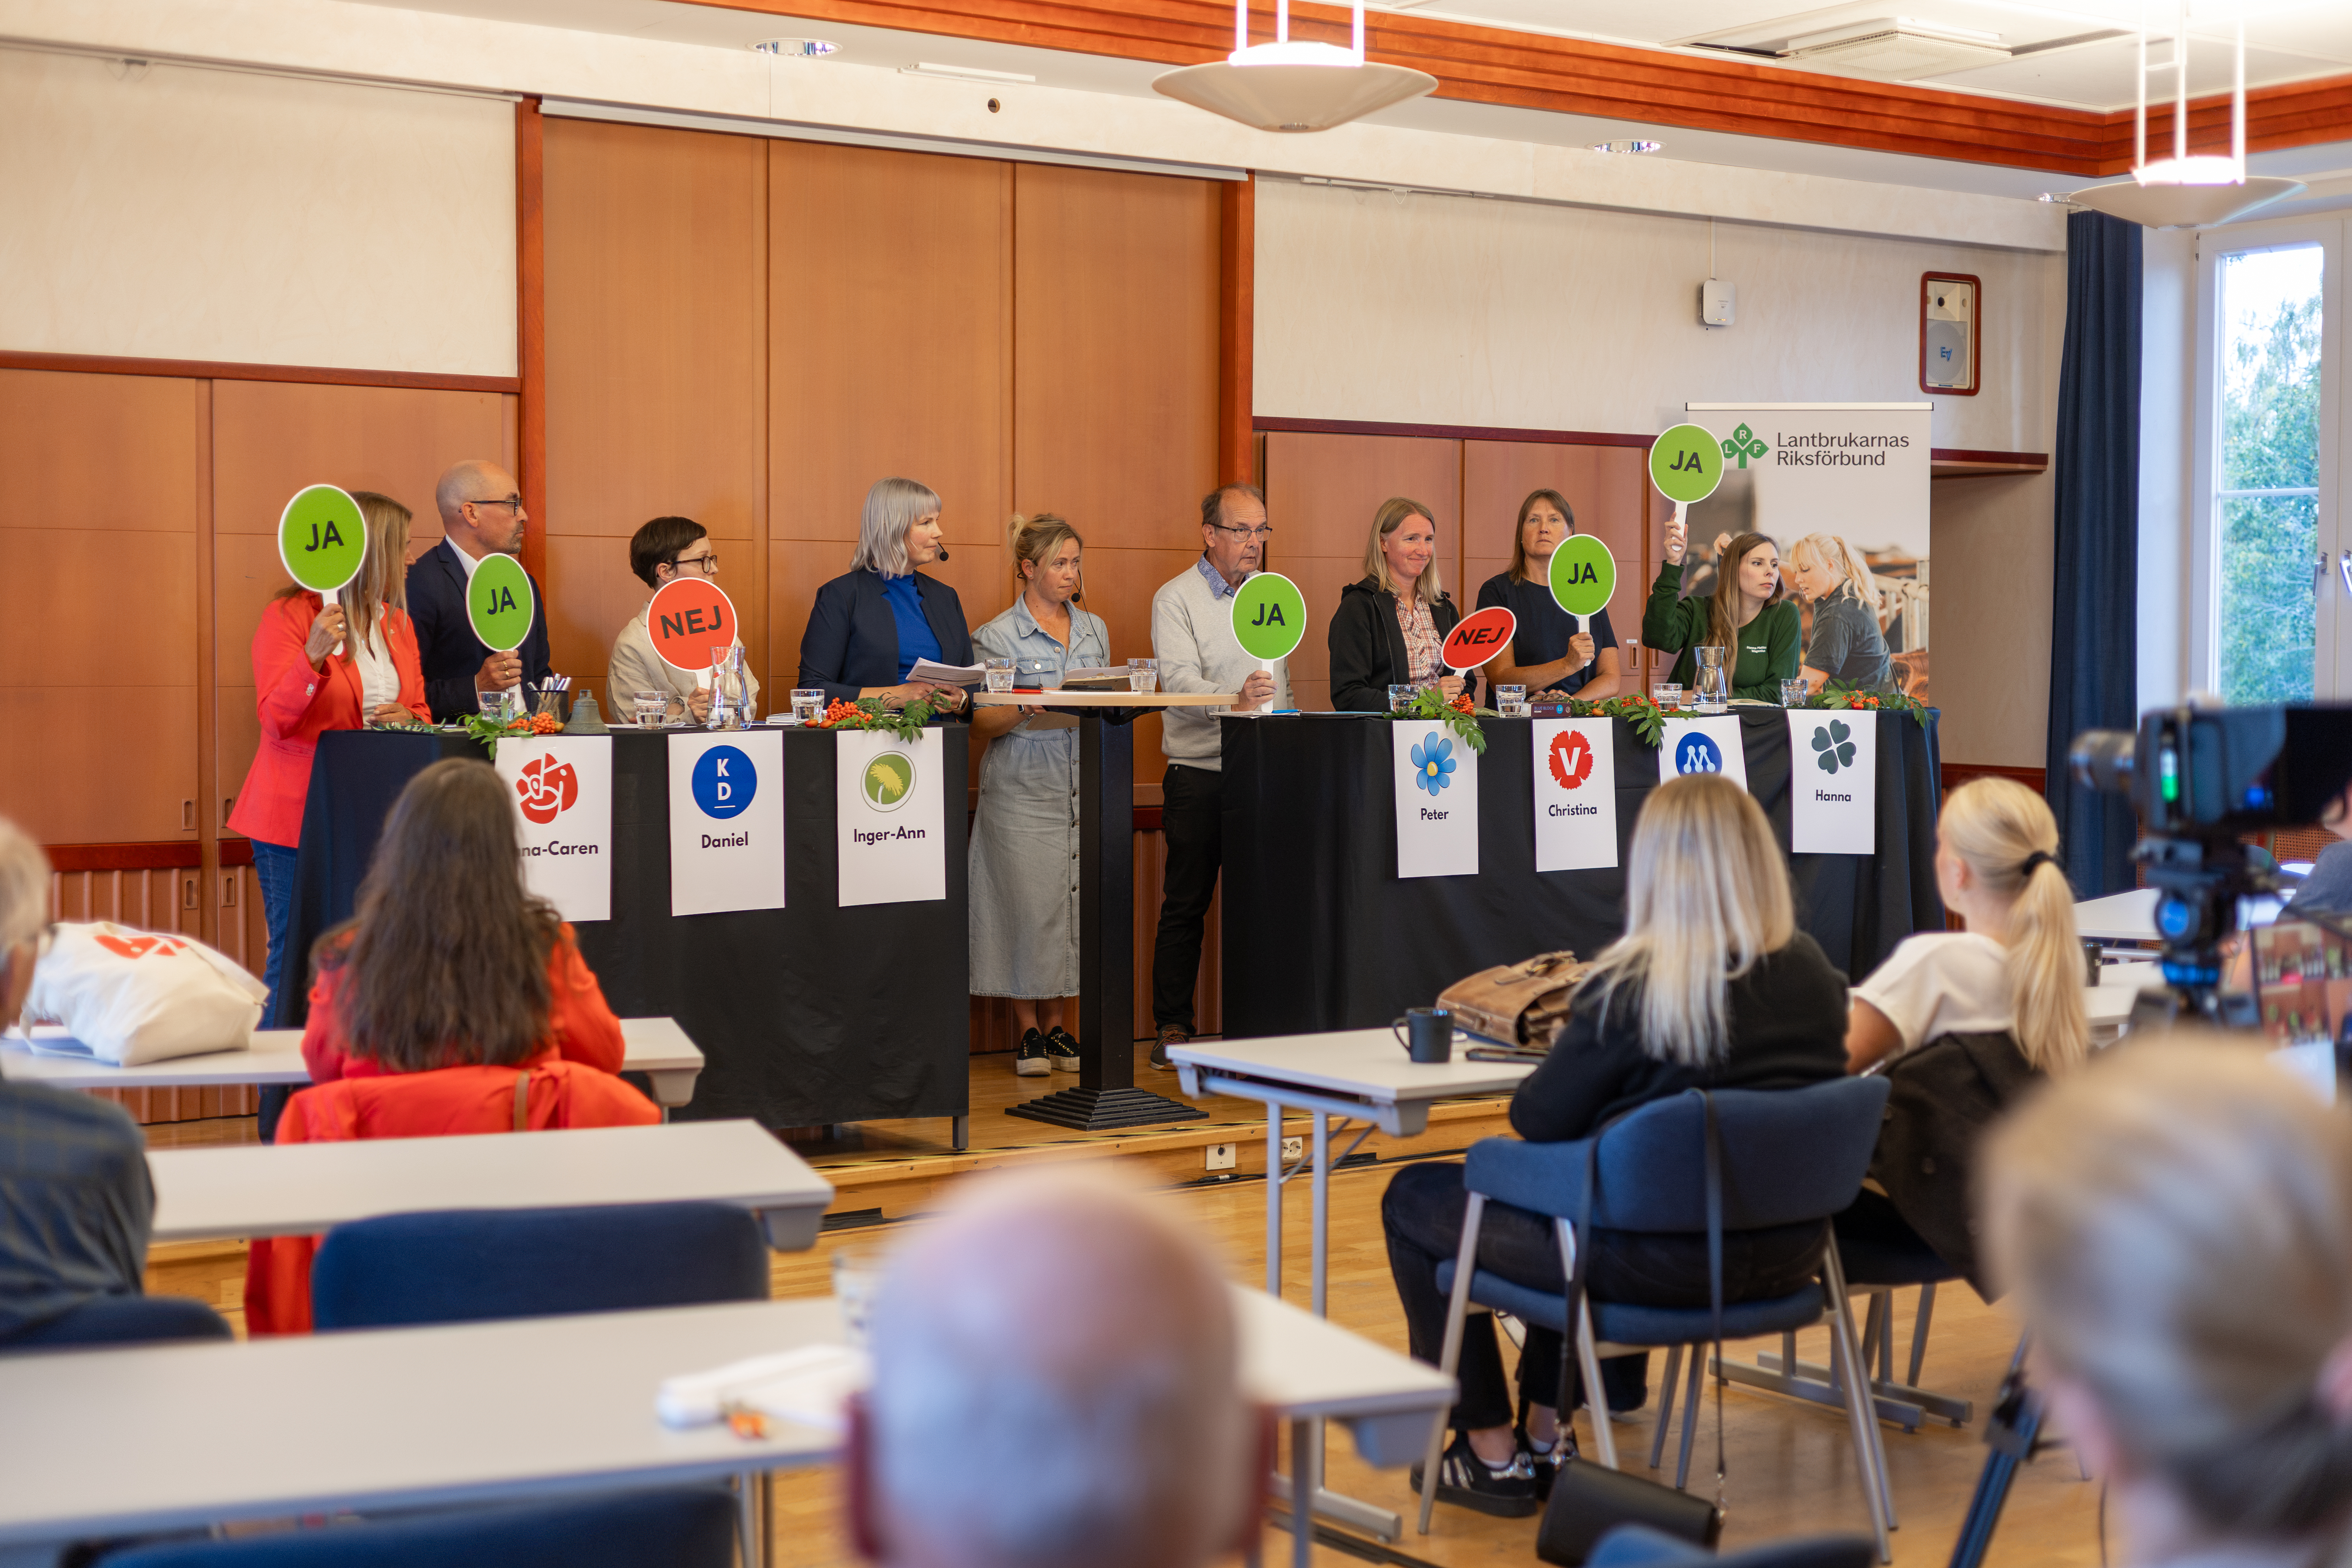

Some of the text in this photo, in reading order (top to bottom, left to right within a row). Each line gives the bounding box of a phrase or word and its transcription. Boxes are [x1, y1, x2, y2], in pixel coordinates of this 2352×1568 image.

[1778, 432, 1909, 447] Lantbrukarnas
[1669, 450, 1703, 474] JA
[1778, 450, 1885, 466] Riksförbund
[305, 520, 344, 552] JA
[1567, 562, 1598, 585] JA
[487, 586, 517, 615] JA
[660, 605, 722, 639] NEJ
[1251, 603, 1286, 626] JA
[1454, 627, 1505, 646] NEJ
[1558, 747, 1581, 776] V
[1816, 789, 1851, 802] Hanna
[1421, 808, 1449, 820] Peter
[1548, 803, 1597, 817] Christina
[702, 831, 748, 849] Daniel
[854, 826, 926, 846] Inger-Ann
[519, 840, 598, 857] na-Caren
